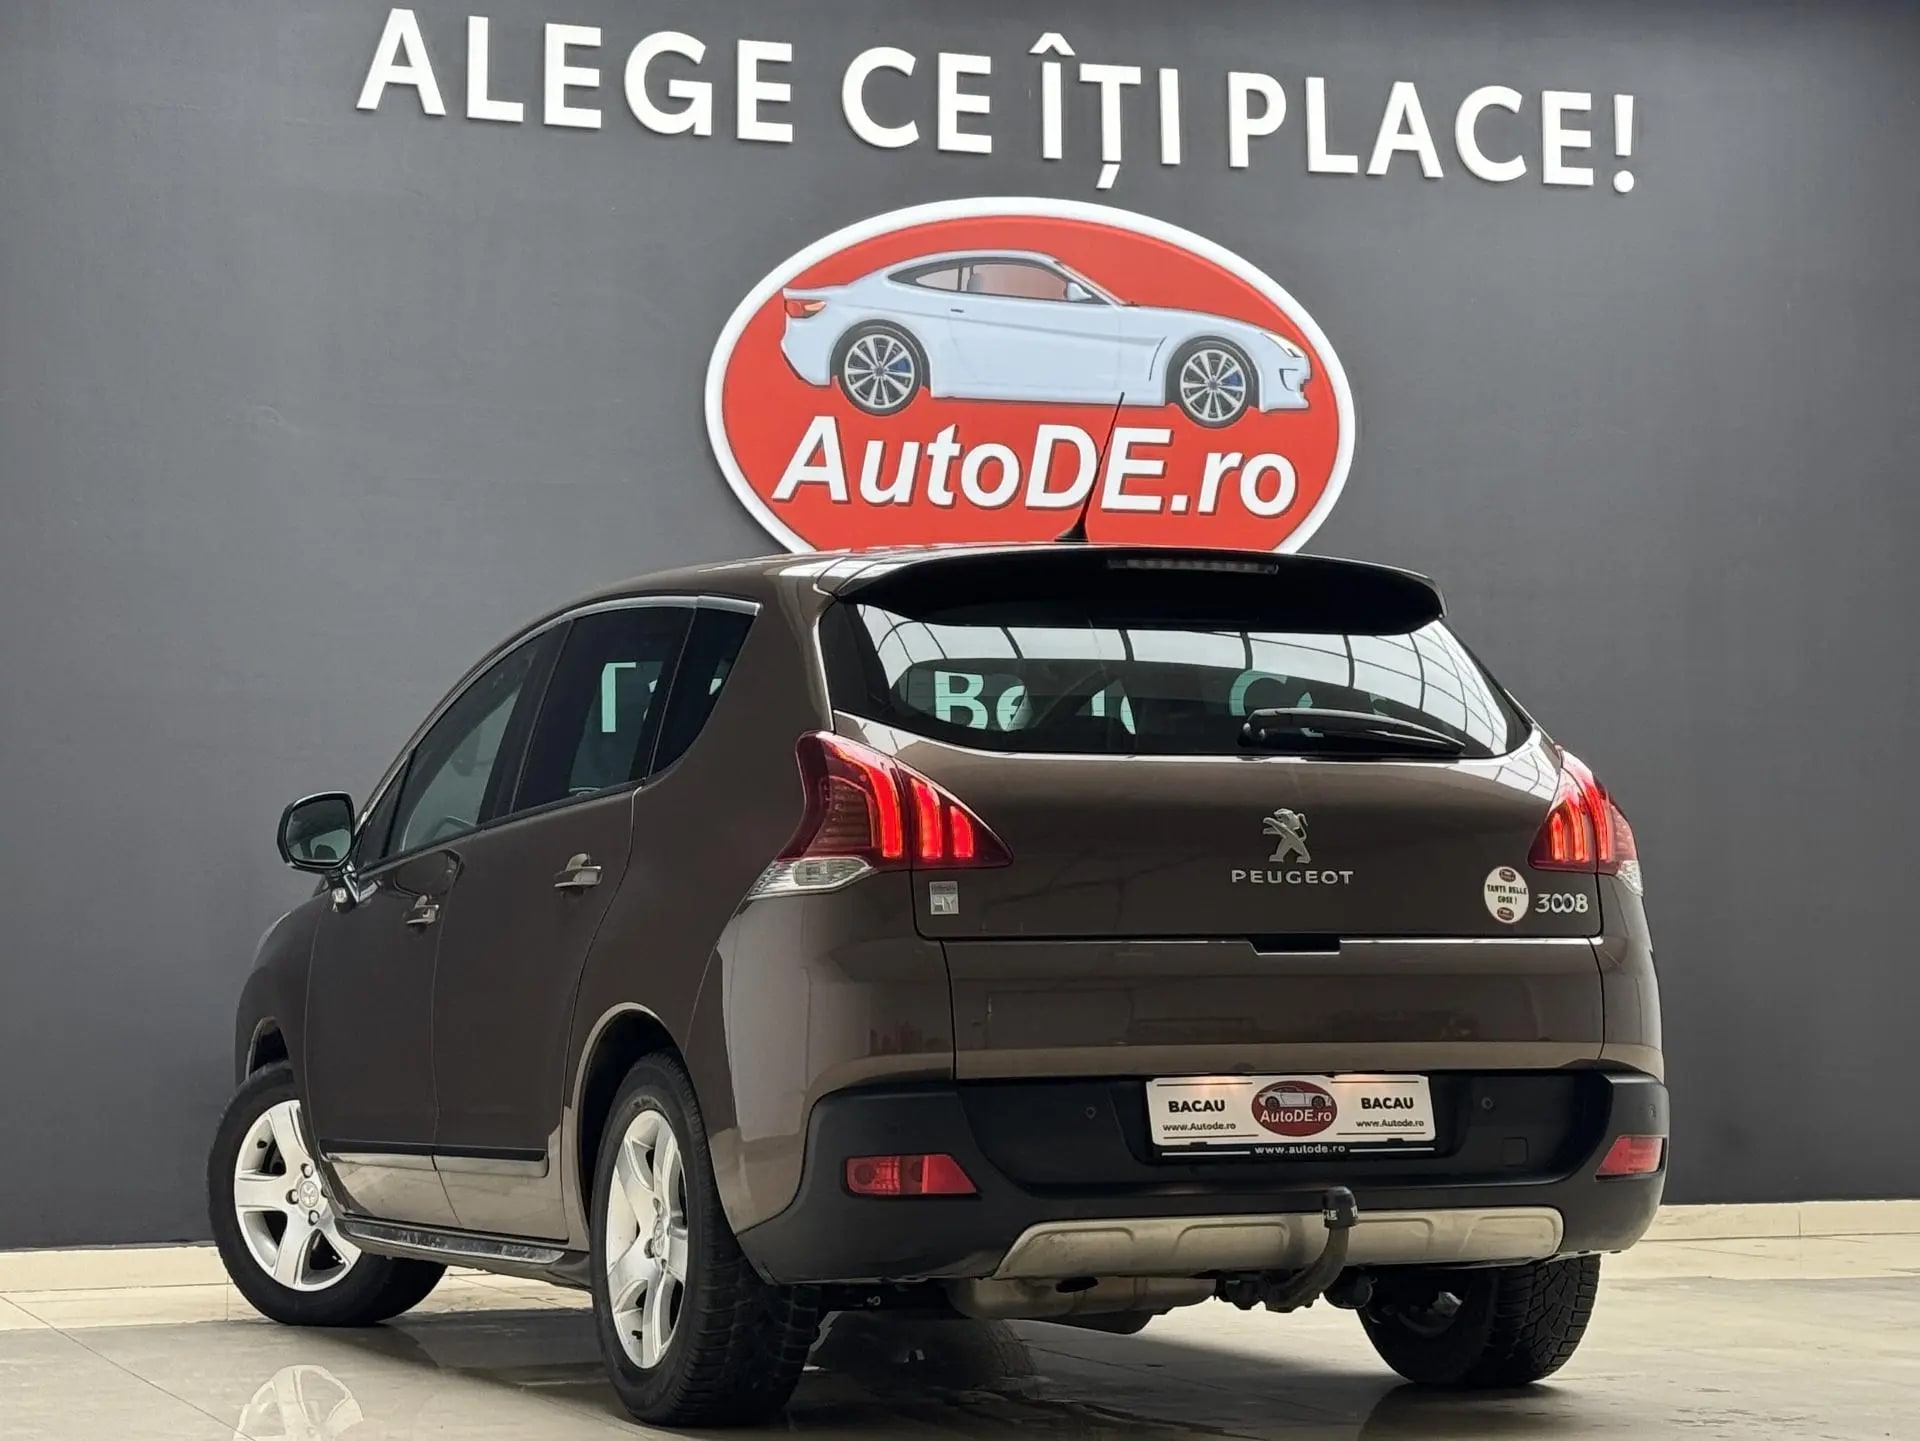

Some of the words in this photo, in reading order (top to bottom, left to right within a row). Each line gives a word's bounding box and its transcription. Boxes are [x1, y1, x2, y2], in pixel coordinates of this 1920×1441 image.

[356, 8, 793, 143] ALEGE
[842, 46, 992, 153] CE
[1228, 71, 1635, 193] PLACE!
[771, 414, 1297, 517] AutoDE.ro
[1231, 869, 1354, 885] PEUGEOT
[1534, 893, 1589, 913] 3008
[1168, 1100, 1225, 1113] BACAU
[1360, 1097, 1414, 1110] BACAU
[1260, 1109, 1333, 1123] AutoDE.ro
[1162, 1121, 1237, 1131] www.Autode.ro
[1356, 1118, 1425, 1128] www.Autode.ro
[1254, 1144, 1346, 1154] www.autode.ro
